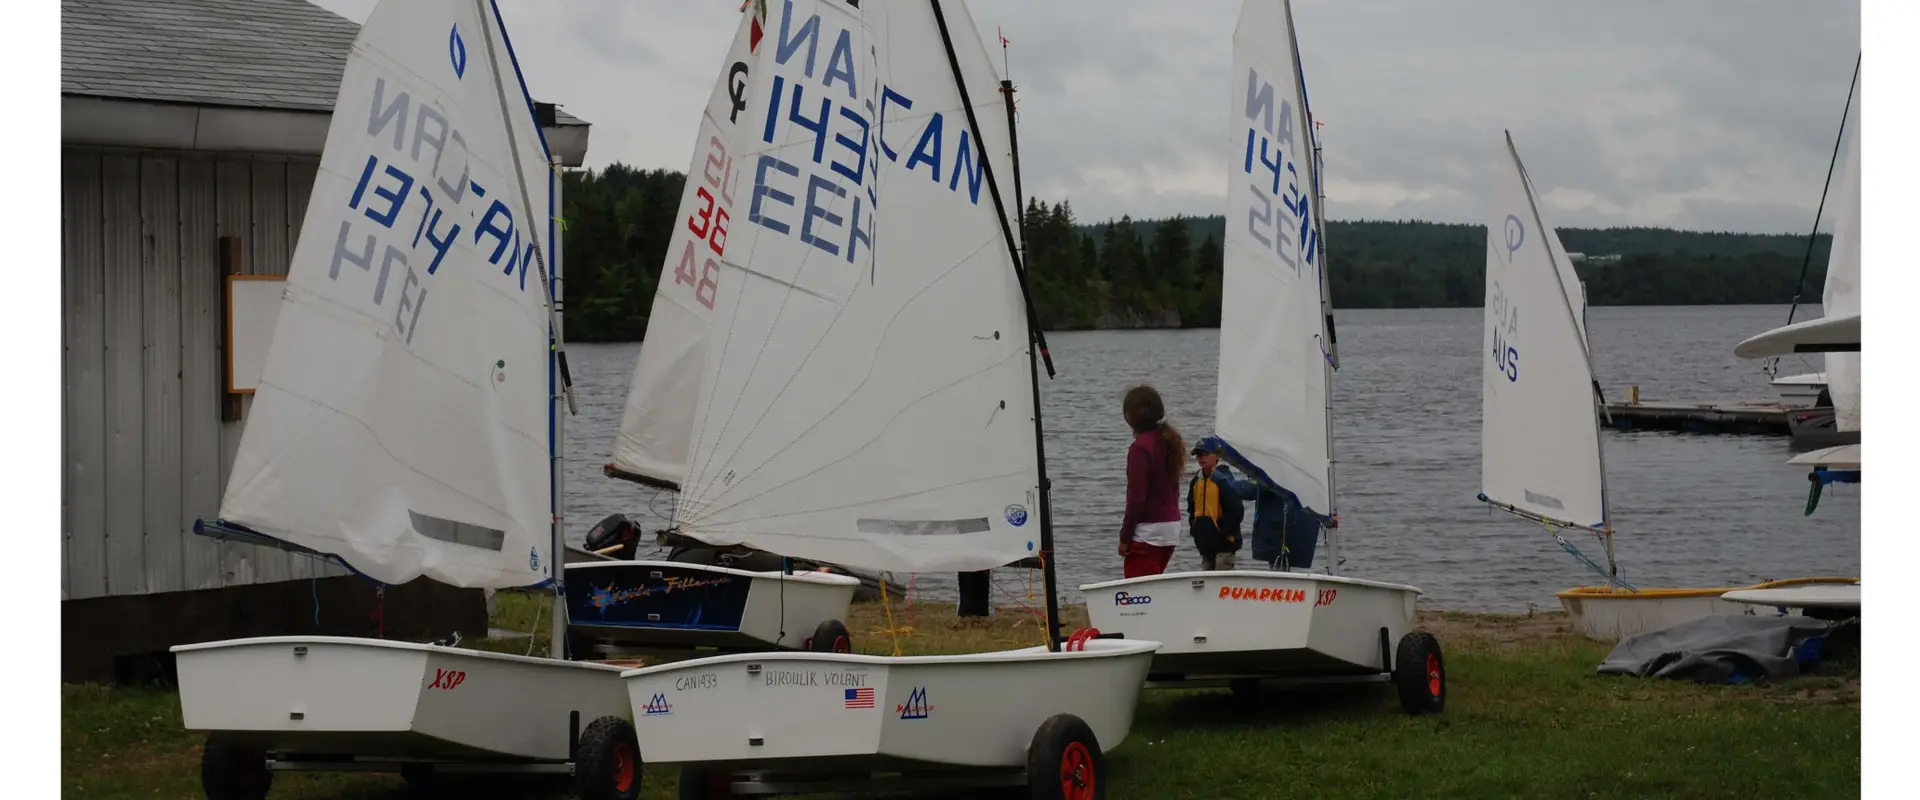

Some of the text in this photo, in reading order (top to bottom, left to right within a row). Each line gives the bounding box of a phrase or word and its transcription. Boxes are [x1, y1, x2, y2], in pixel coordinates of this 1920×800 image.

[880, 83, 984, 206] CAN
[1492, 325, 1518, 382] AUS
[1219, 586, 1306, 603] PUMPKIN
[1313, 588, 1337, 608] XSP
[427, 667, 466, 690] XSP
